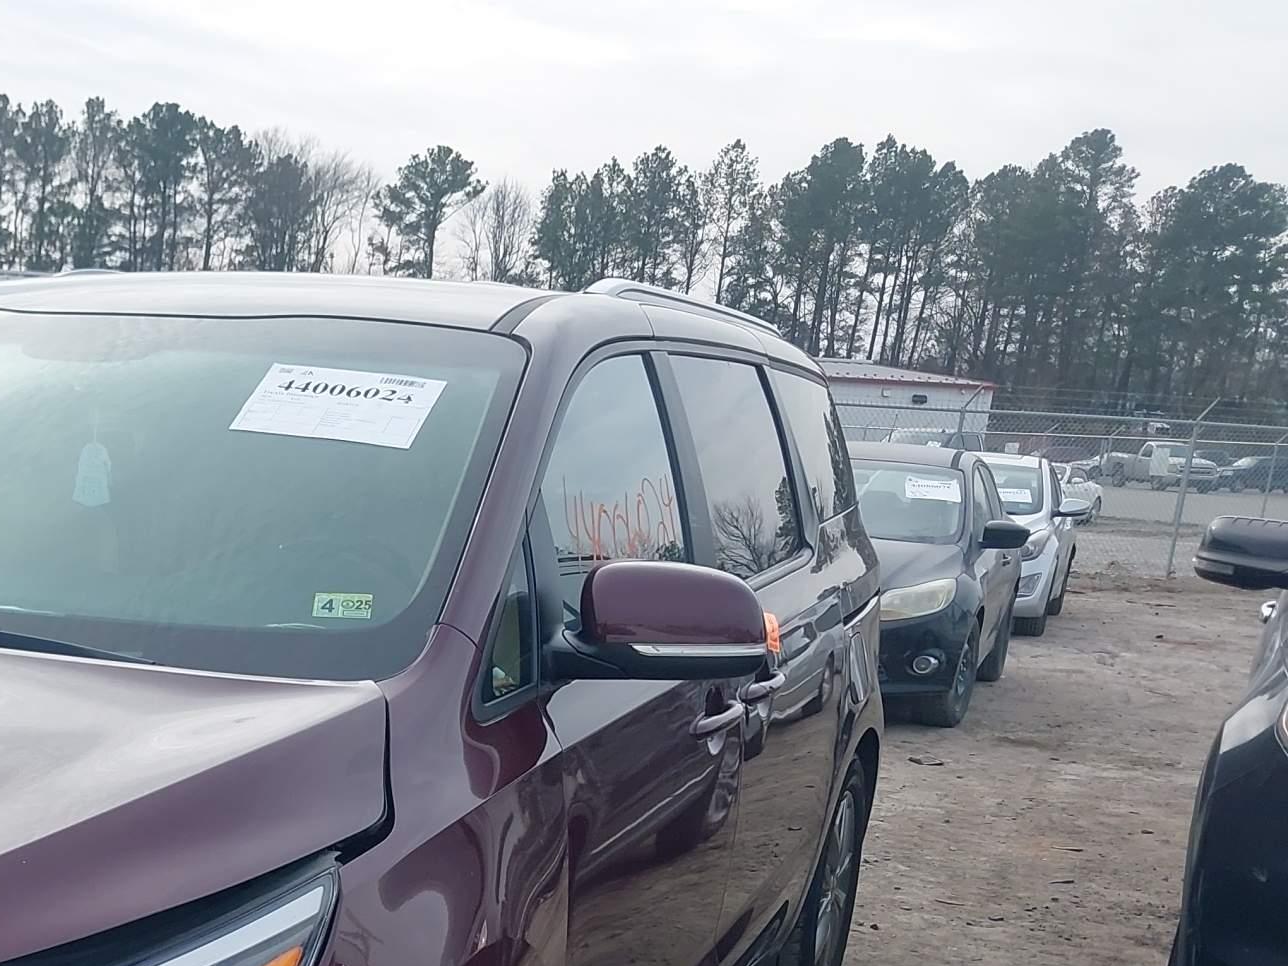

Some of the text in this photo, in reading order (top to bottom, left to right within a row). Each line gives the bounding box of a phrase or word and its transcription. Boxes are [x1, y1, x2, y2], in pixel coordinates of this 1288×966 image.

[277, 379, 415, 404] 44006024
[320, 599, 372, 613] 4 25
